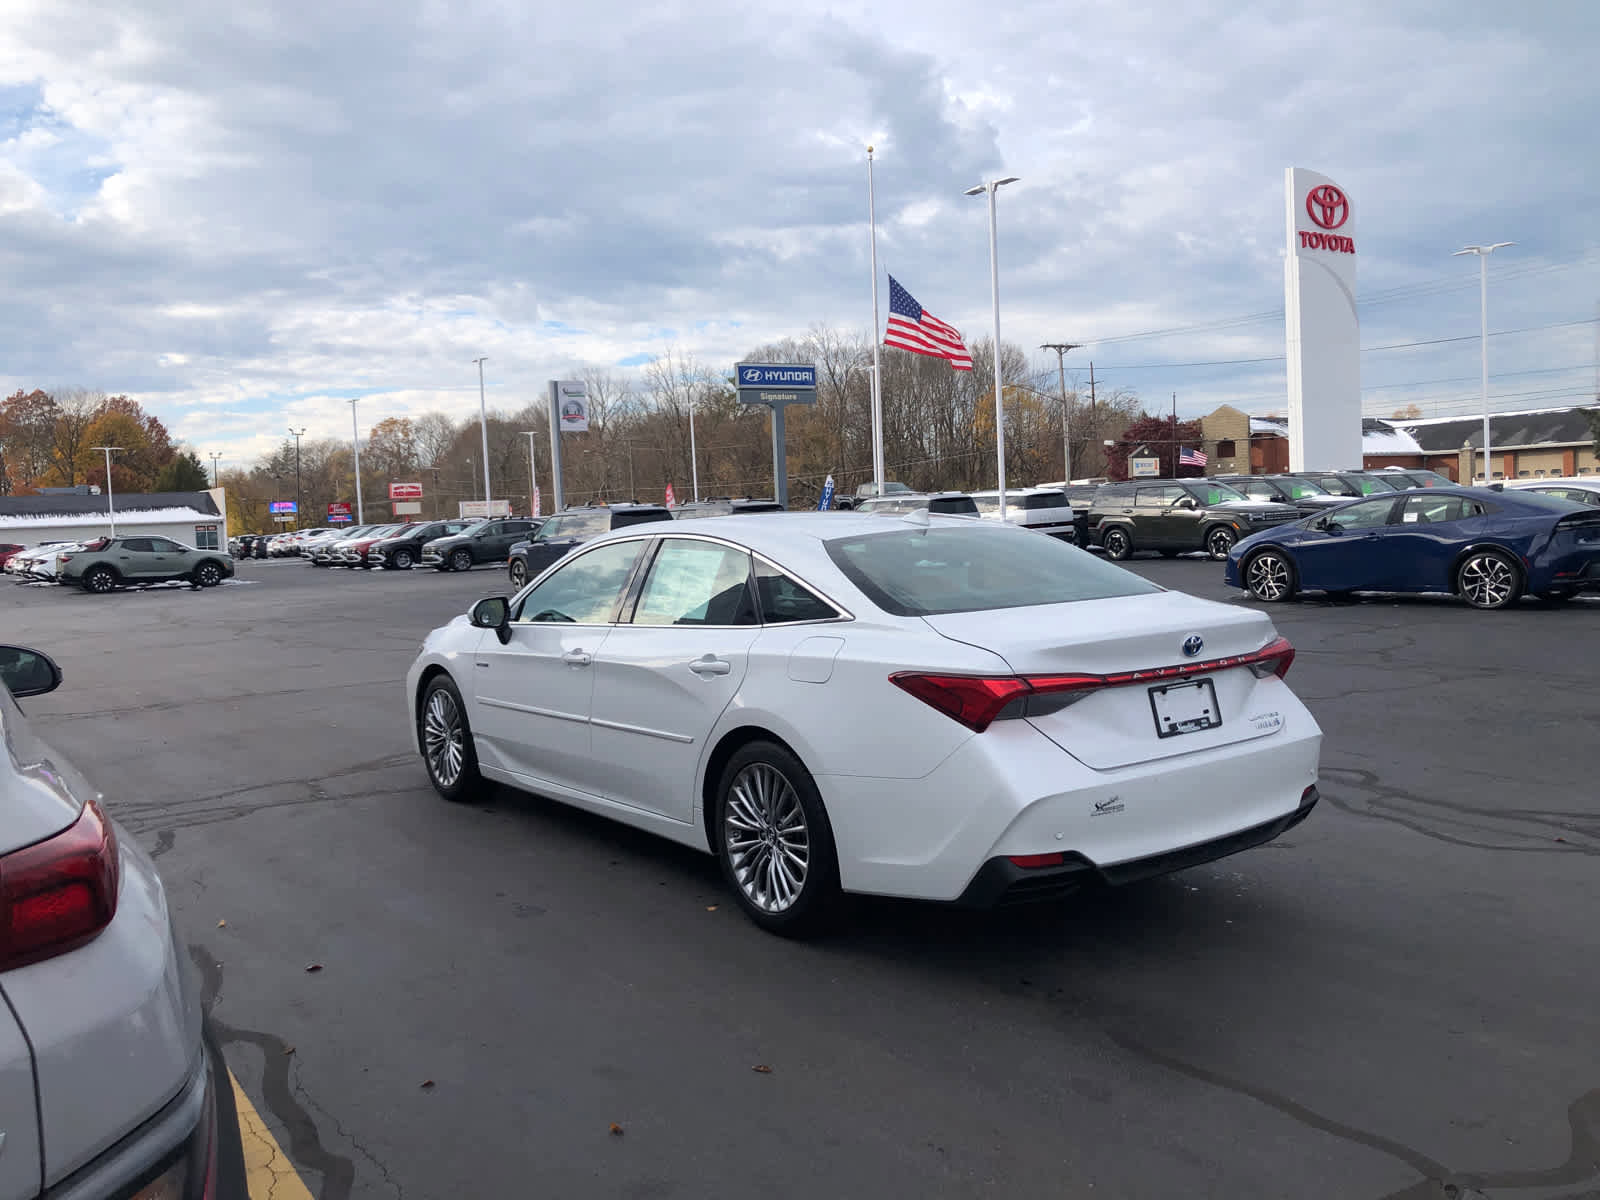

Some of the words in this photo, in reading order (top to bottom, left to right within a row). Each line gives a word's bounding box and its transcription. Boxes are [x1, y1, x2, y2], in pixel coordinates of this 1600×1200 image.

[1299, 231, 1355, 254] TOYOTA
[764, 371, 812, 381] HYUNDAI
[760, 392, 797, 401] Signature
[1132, 657, 1245, 679] AVALON
